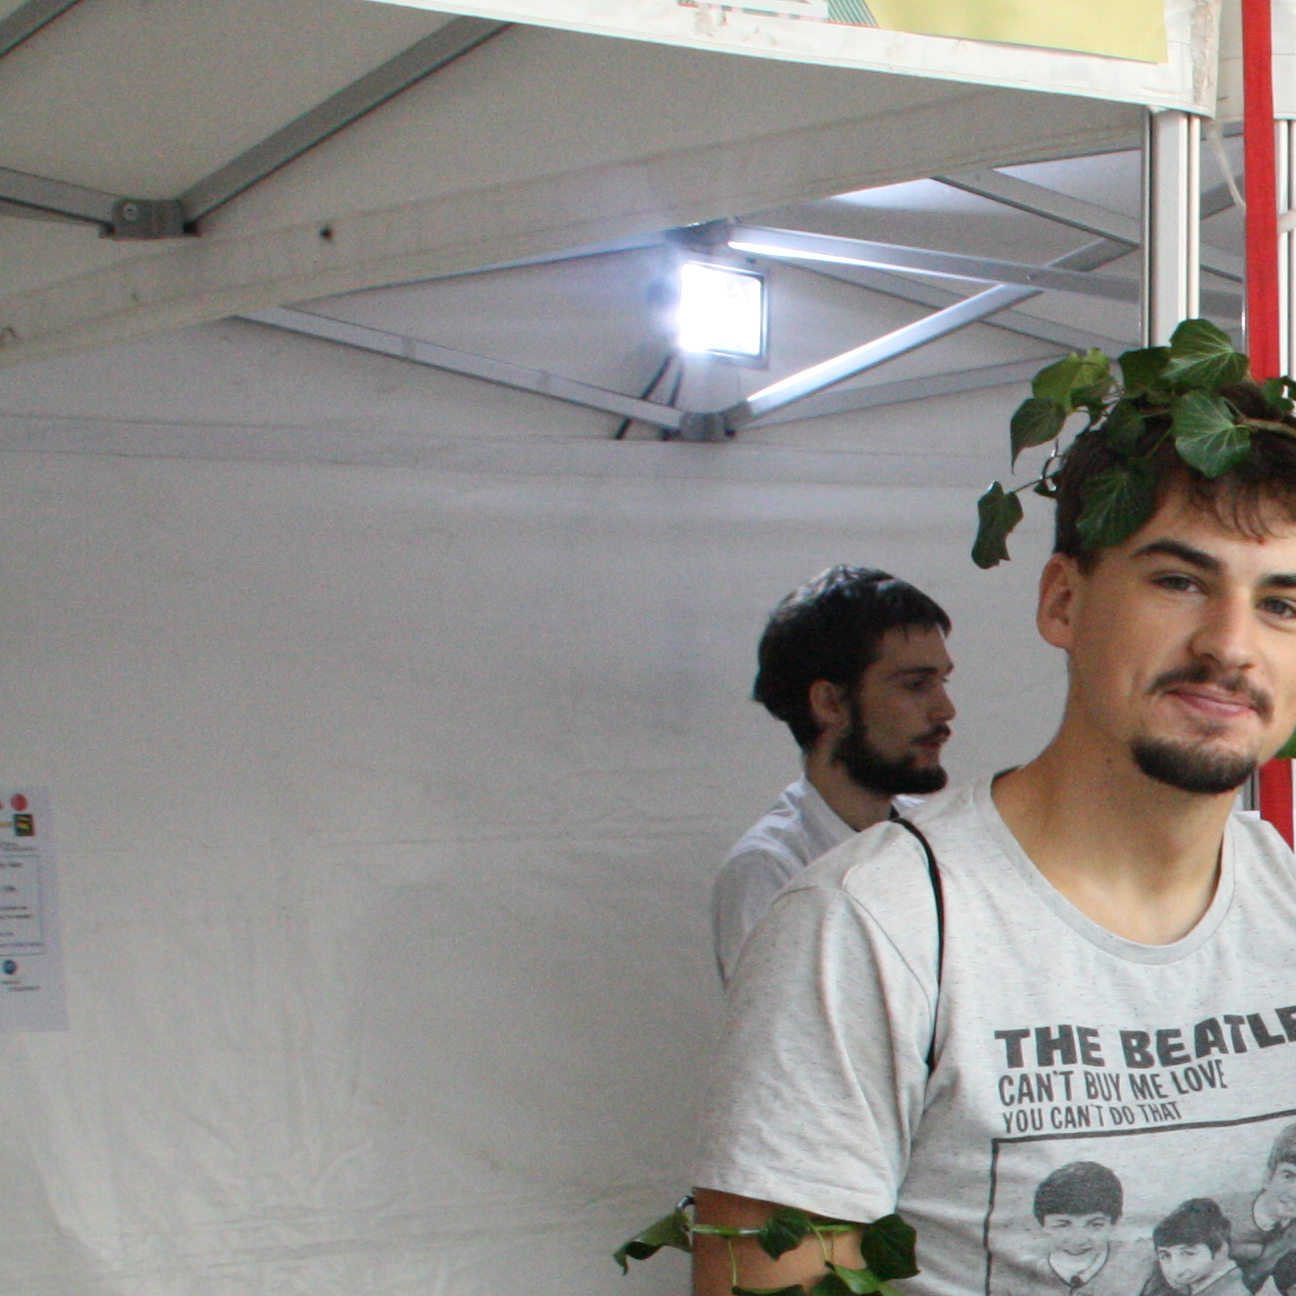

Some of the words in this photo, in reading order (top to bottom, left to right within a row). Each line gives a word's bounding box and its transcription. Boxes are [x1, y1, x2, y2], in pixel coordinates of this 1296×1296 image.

[995, 1024, 1105, 1069] THE
[998, 1069, 1075, 1107] CAN'T
[1083, 1070, 1122, 1102] BUY
[1128, 1072, 1169, 1101] ME
[1170, 1059, 1229, 1093] LOVE
[1002, 1108, 1044, 1134] YOU
[1050, 1104, 1105, 1129] CAN'T
[1110, 1105, 1136, 1126] DO
[1139, 1101, 1183, 1123] THAT
